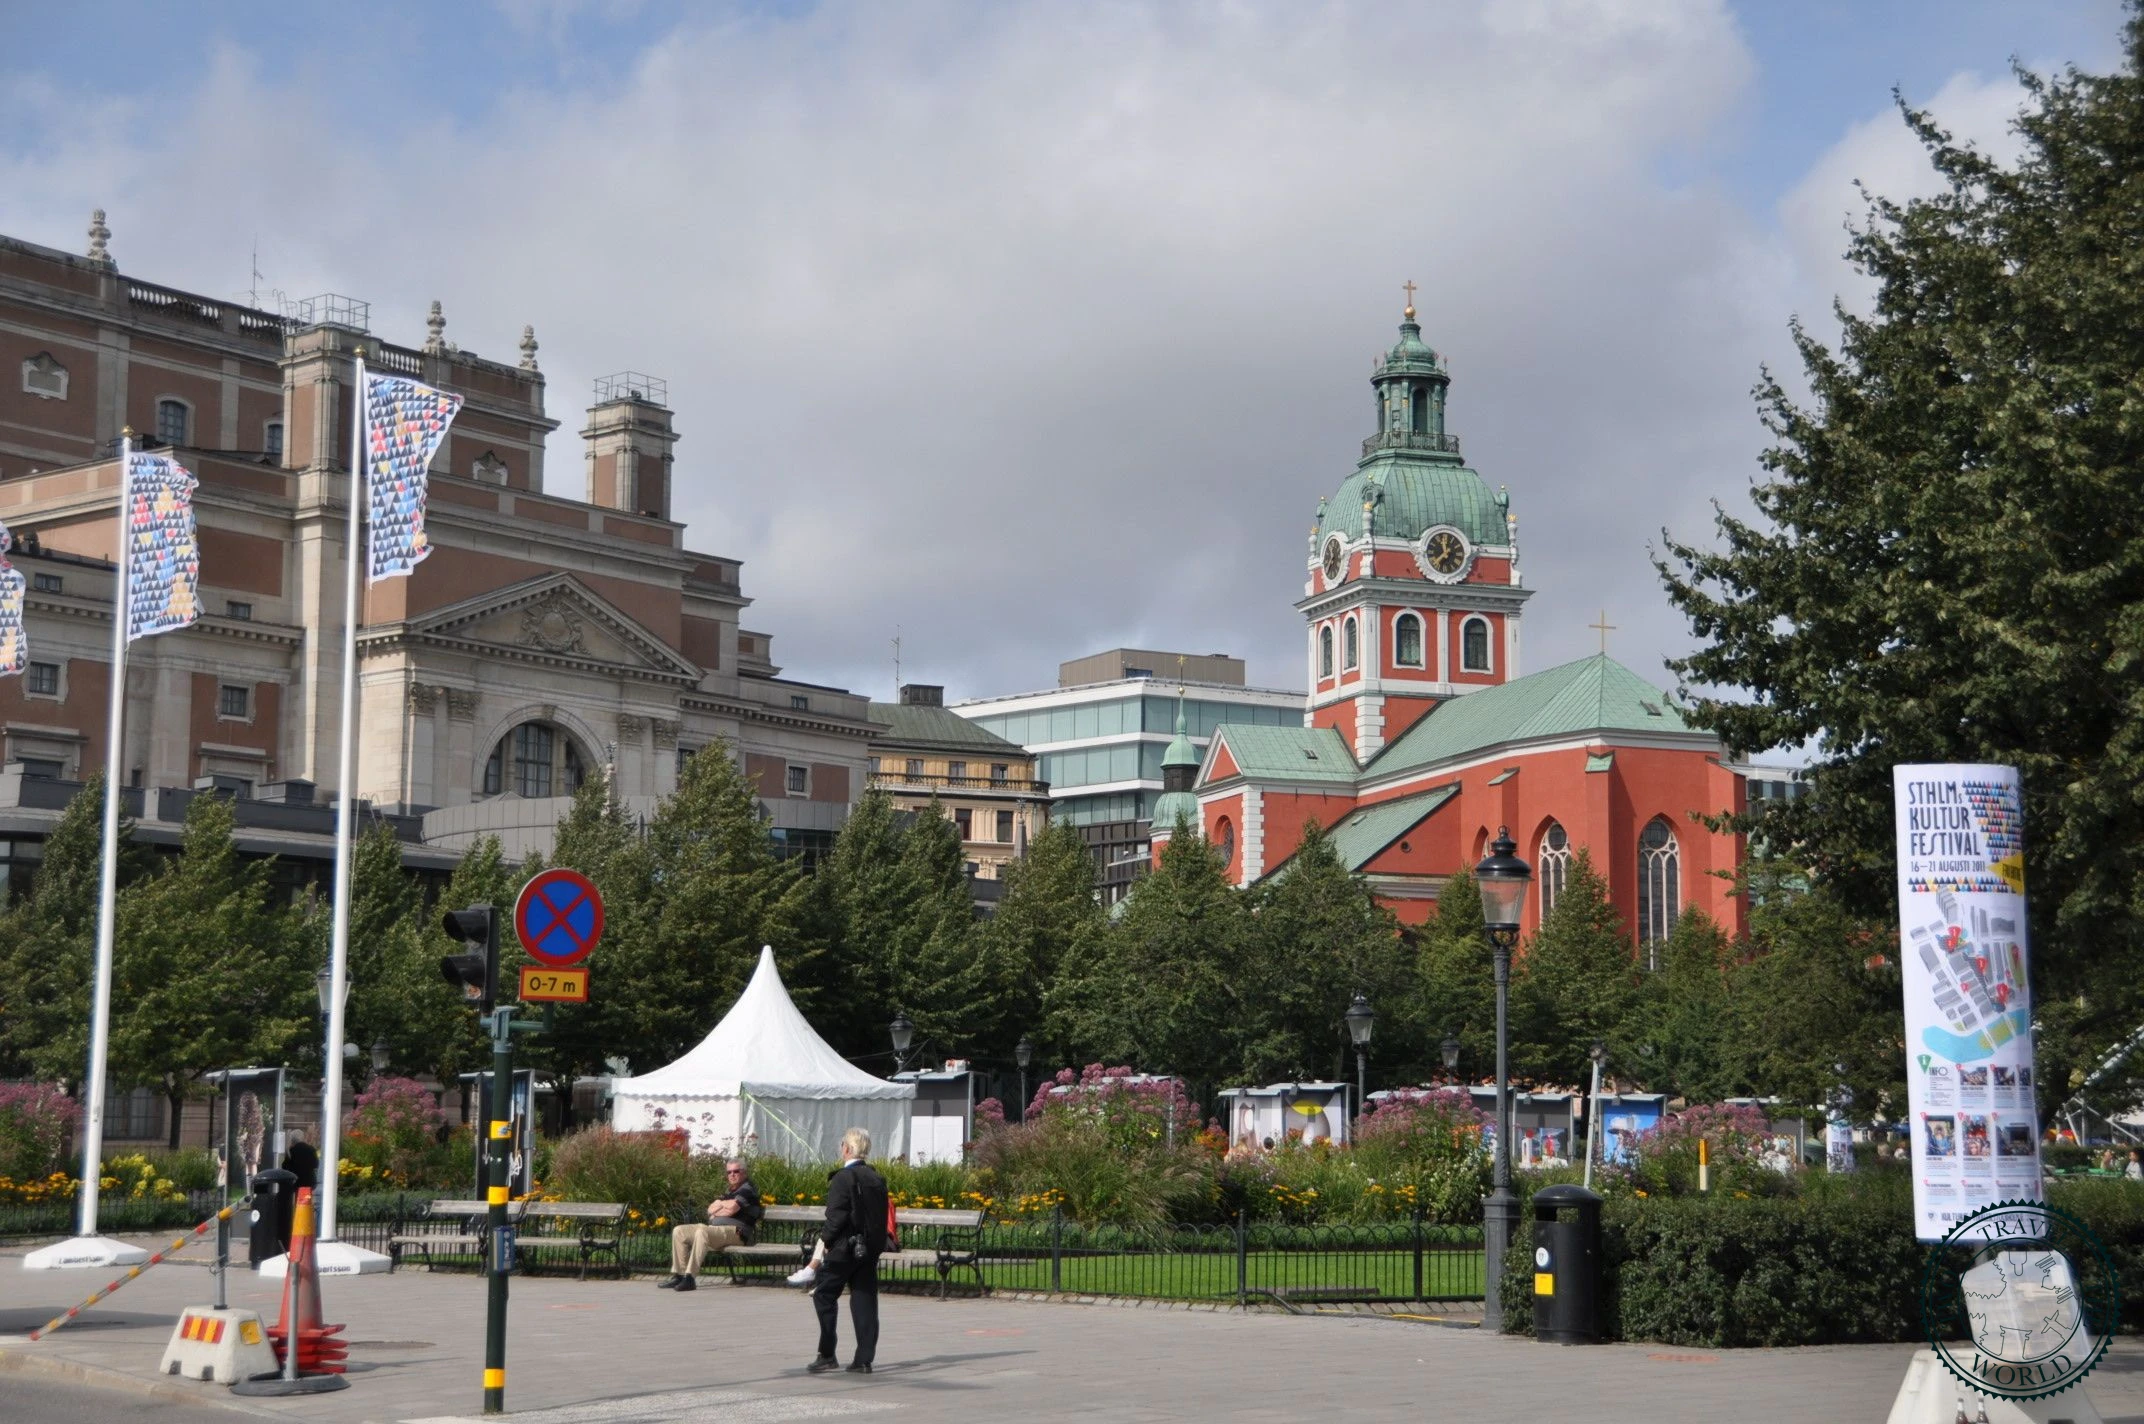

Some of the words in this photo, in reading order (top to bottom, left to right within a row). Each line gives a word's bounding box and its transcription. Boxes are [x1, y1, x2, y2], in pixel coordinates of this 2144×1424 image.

[1909, 806, 1970, 830] KULTUR
[1910, 832, 1981, 856] FESTIVAL
[1939, 860, 1970, 872] AUGUSTI
[1972, 860, 1986, 872] 2011
[529, 976, 558, 992] 0-7
[563, 981, 576, 993] m
[1929, 1066, 1949, 1077] INFO
